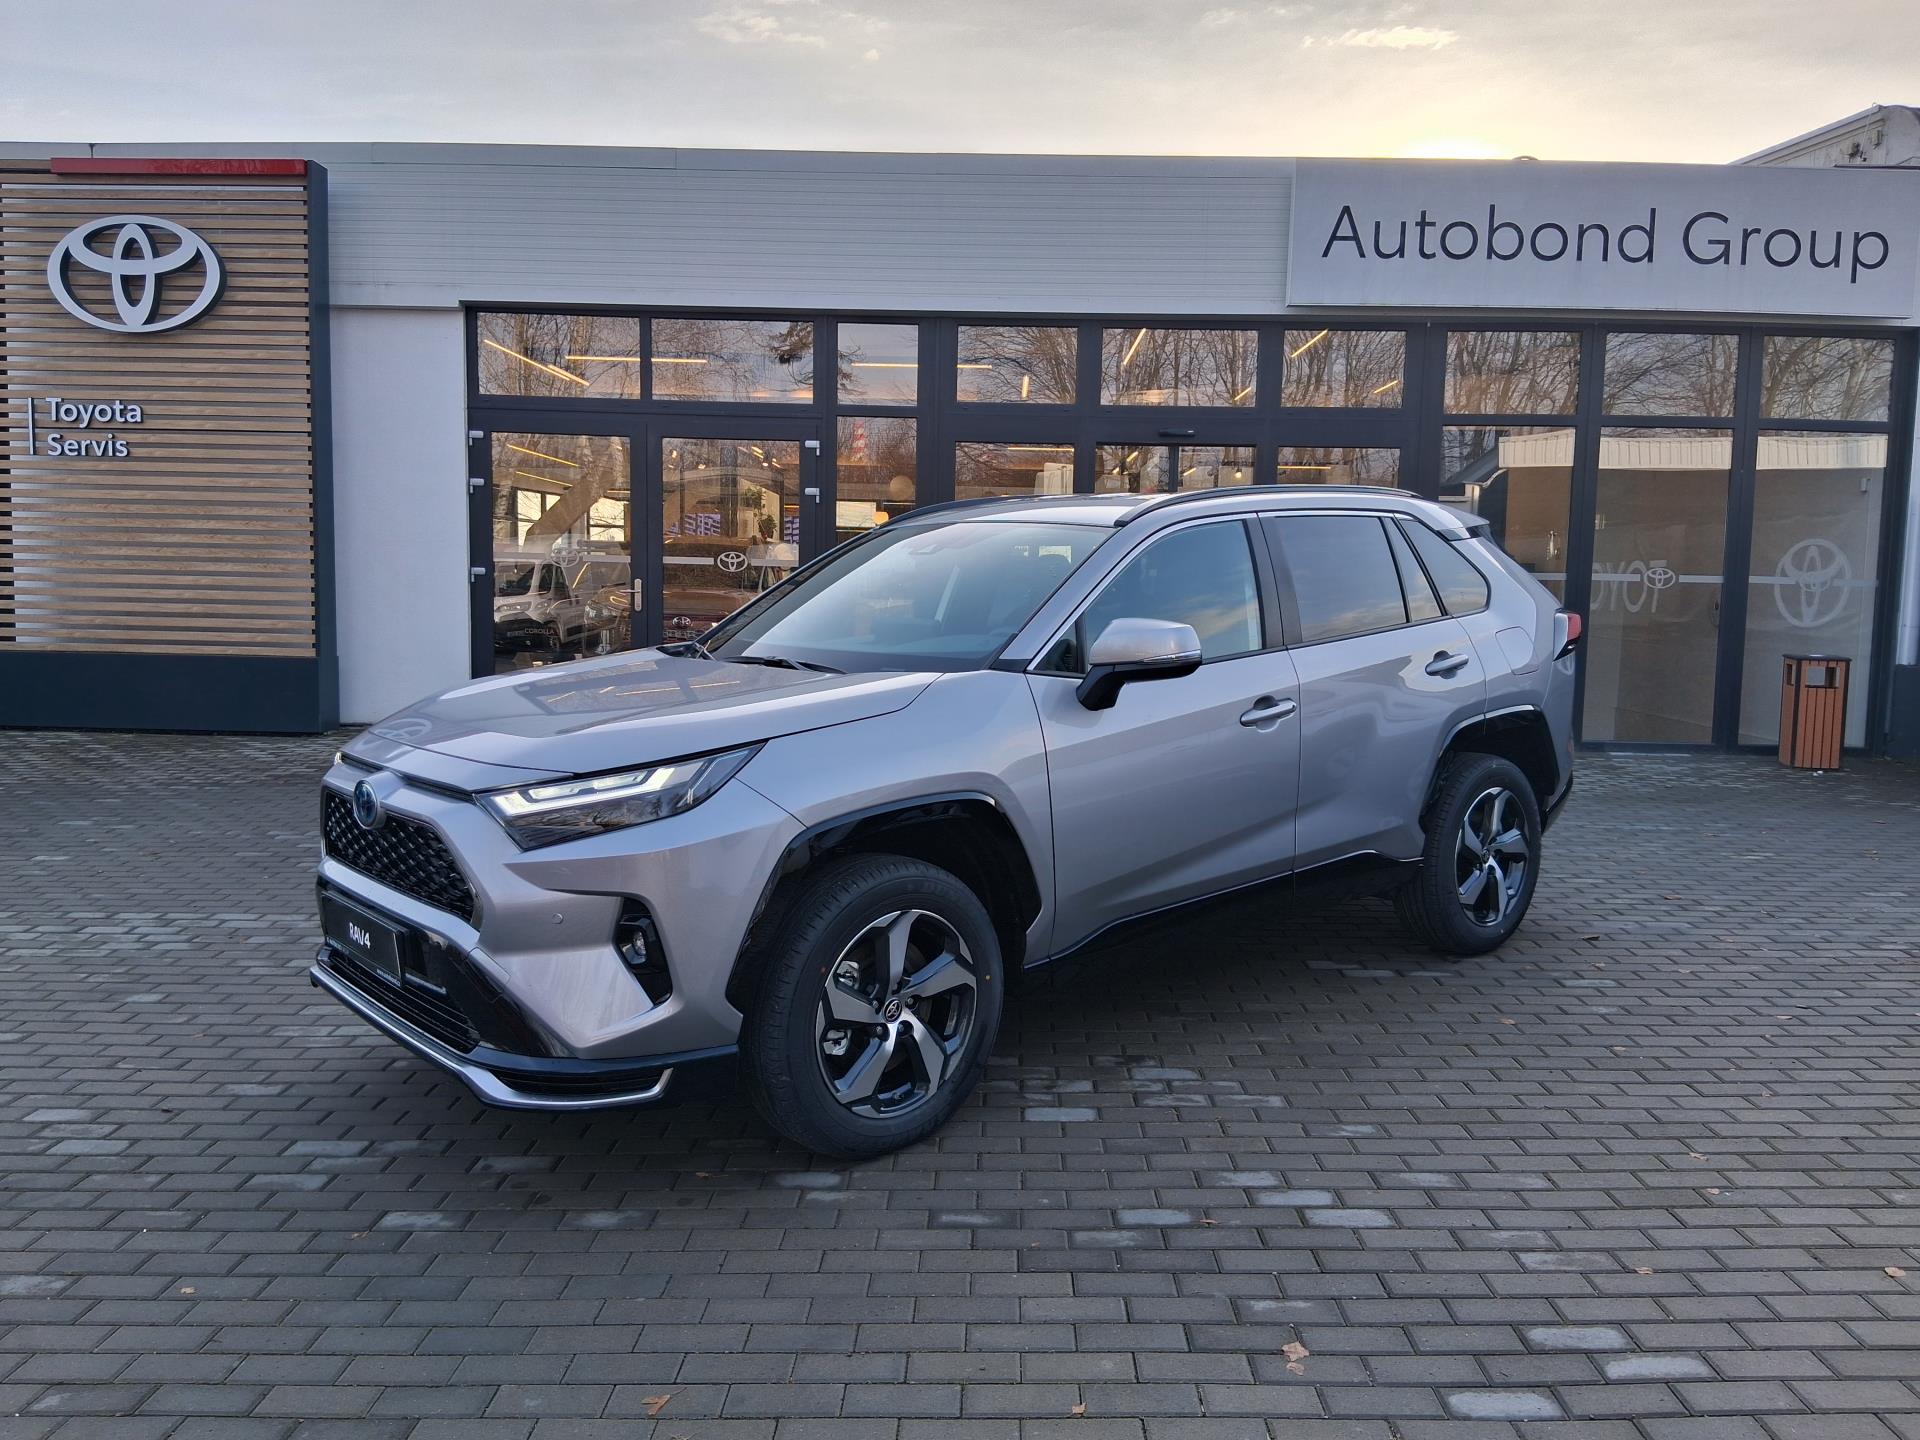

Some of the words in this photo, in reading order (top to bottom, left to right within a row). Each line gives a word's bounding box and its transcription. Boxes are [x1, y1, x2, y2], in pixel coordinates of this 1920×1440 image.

[1321, 203, 1657, 264] Autobond
[1682, 211, 1889, 284] Group
[45, 397, 142, 428] Toyota
[47, 433, 129, 457] Servis
[524, 627, 555, 635] COROLLA
[349, 921, 371, 949] RAV4
